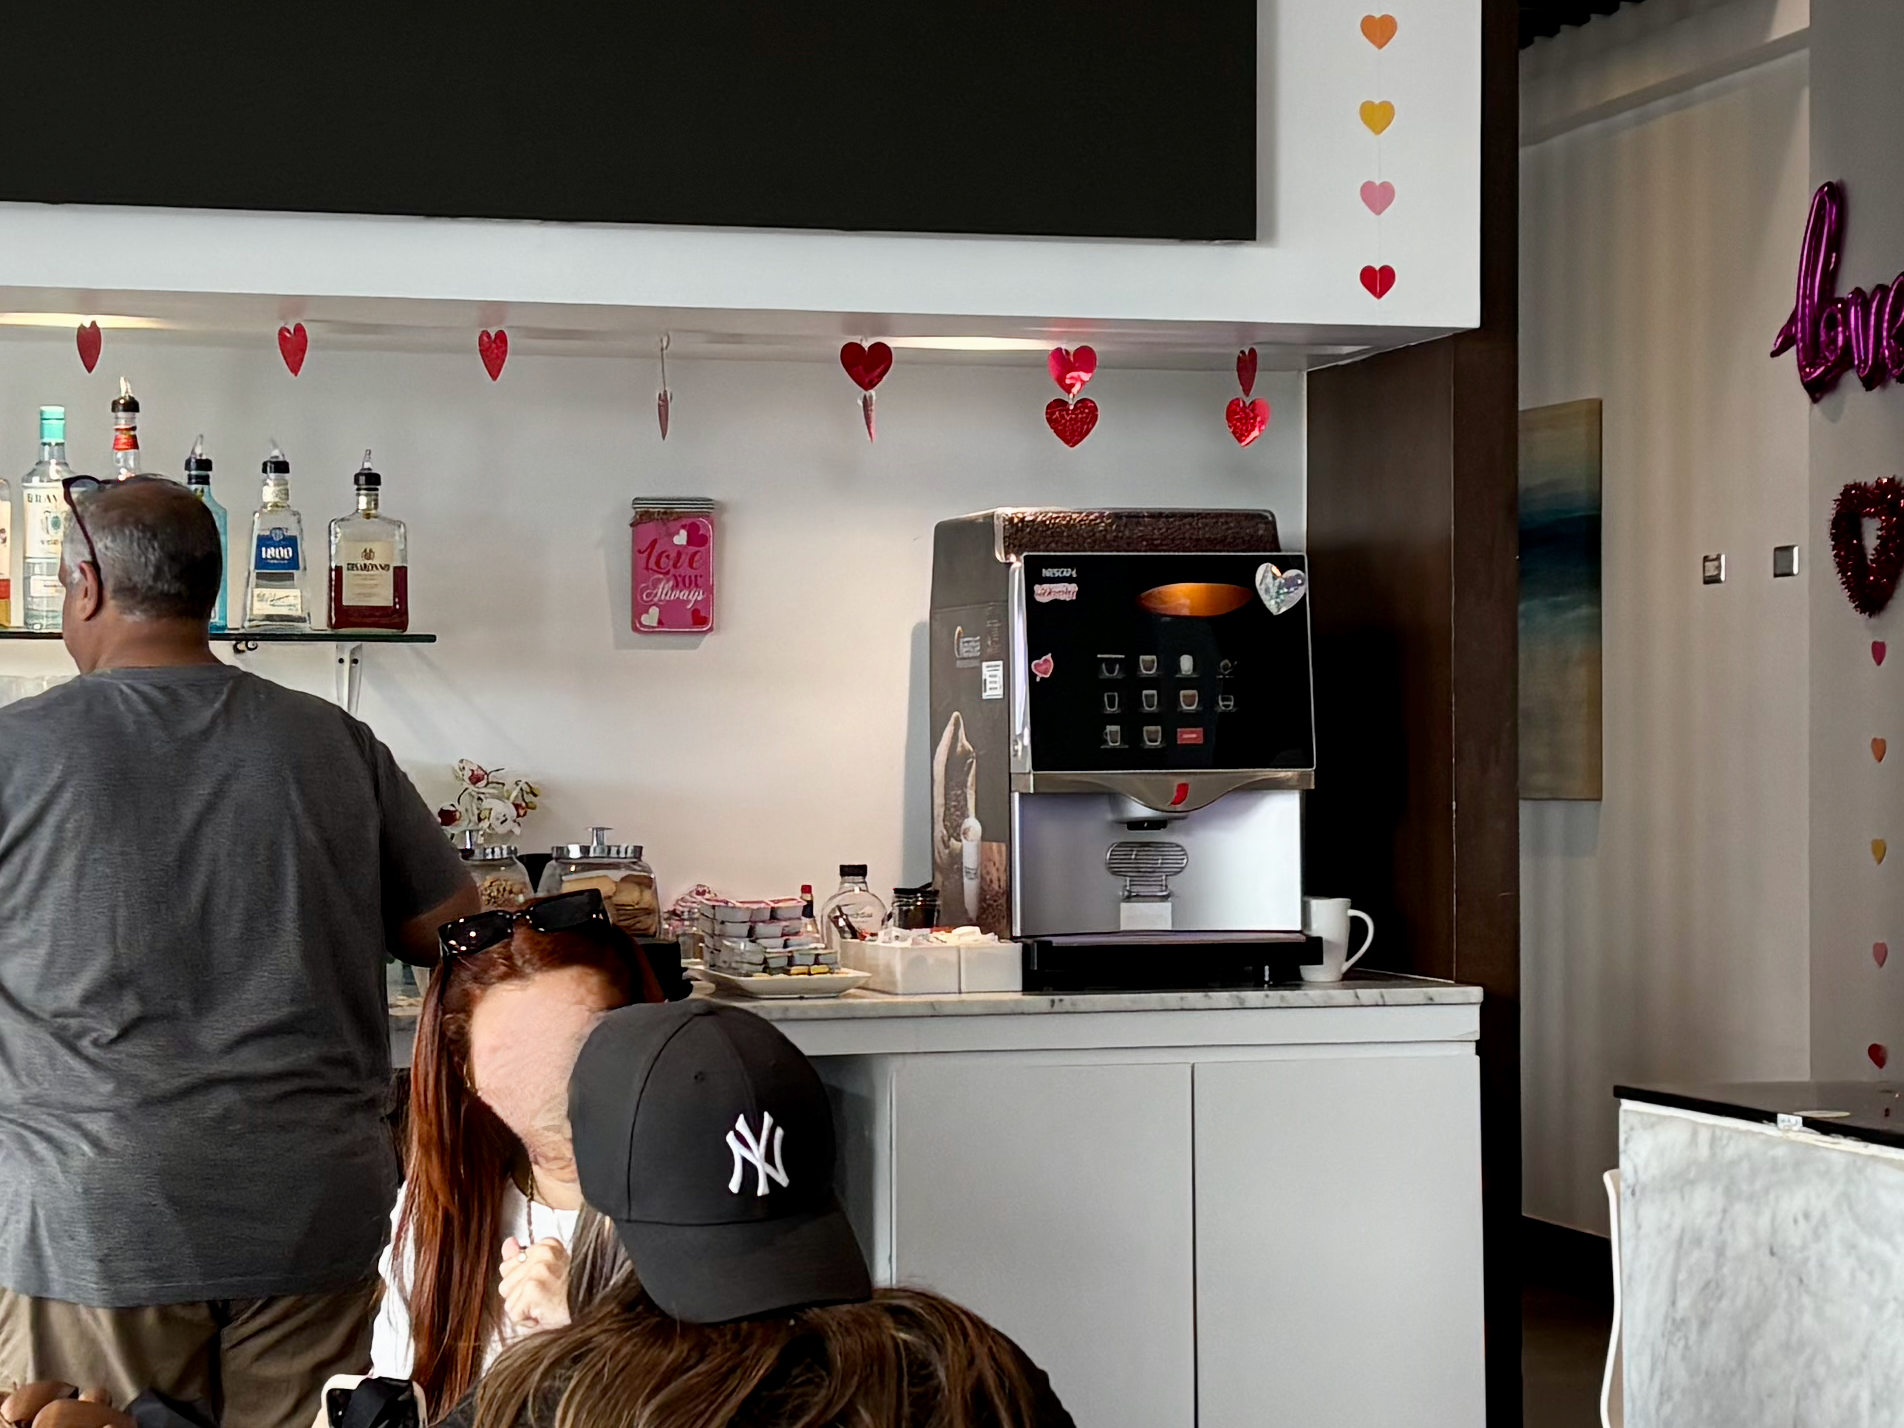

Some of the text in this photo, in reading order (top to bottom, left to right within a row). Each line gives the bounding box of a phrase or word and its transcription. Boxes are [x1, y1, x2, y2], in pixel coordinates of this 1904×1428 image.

[261, 546, 294, 559] 1800
[640, 574, 705, 609] Always
[725, 1110, 790, 1197] NY
